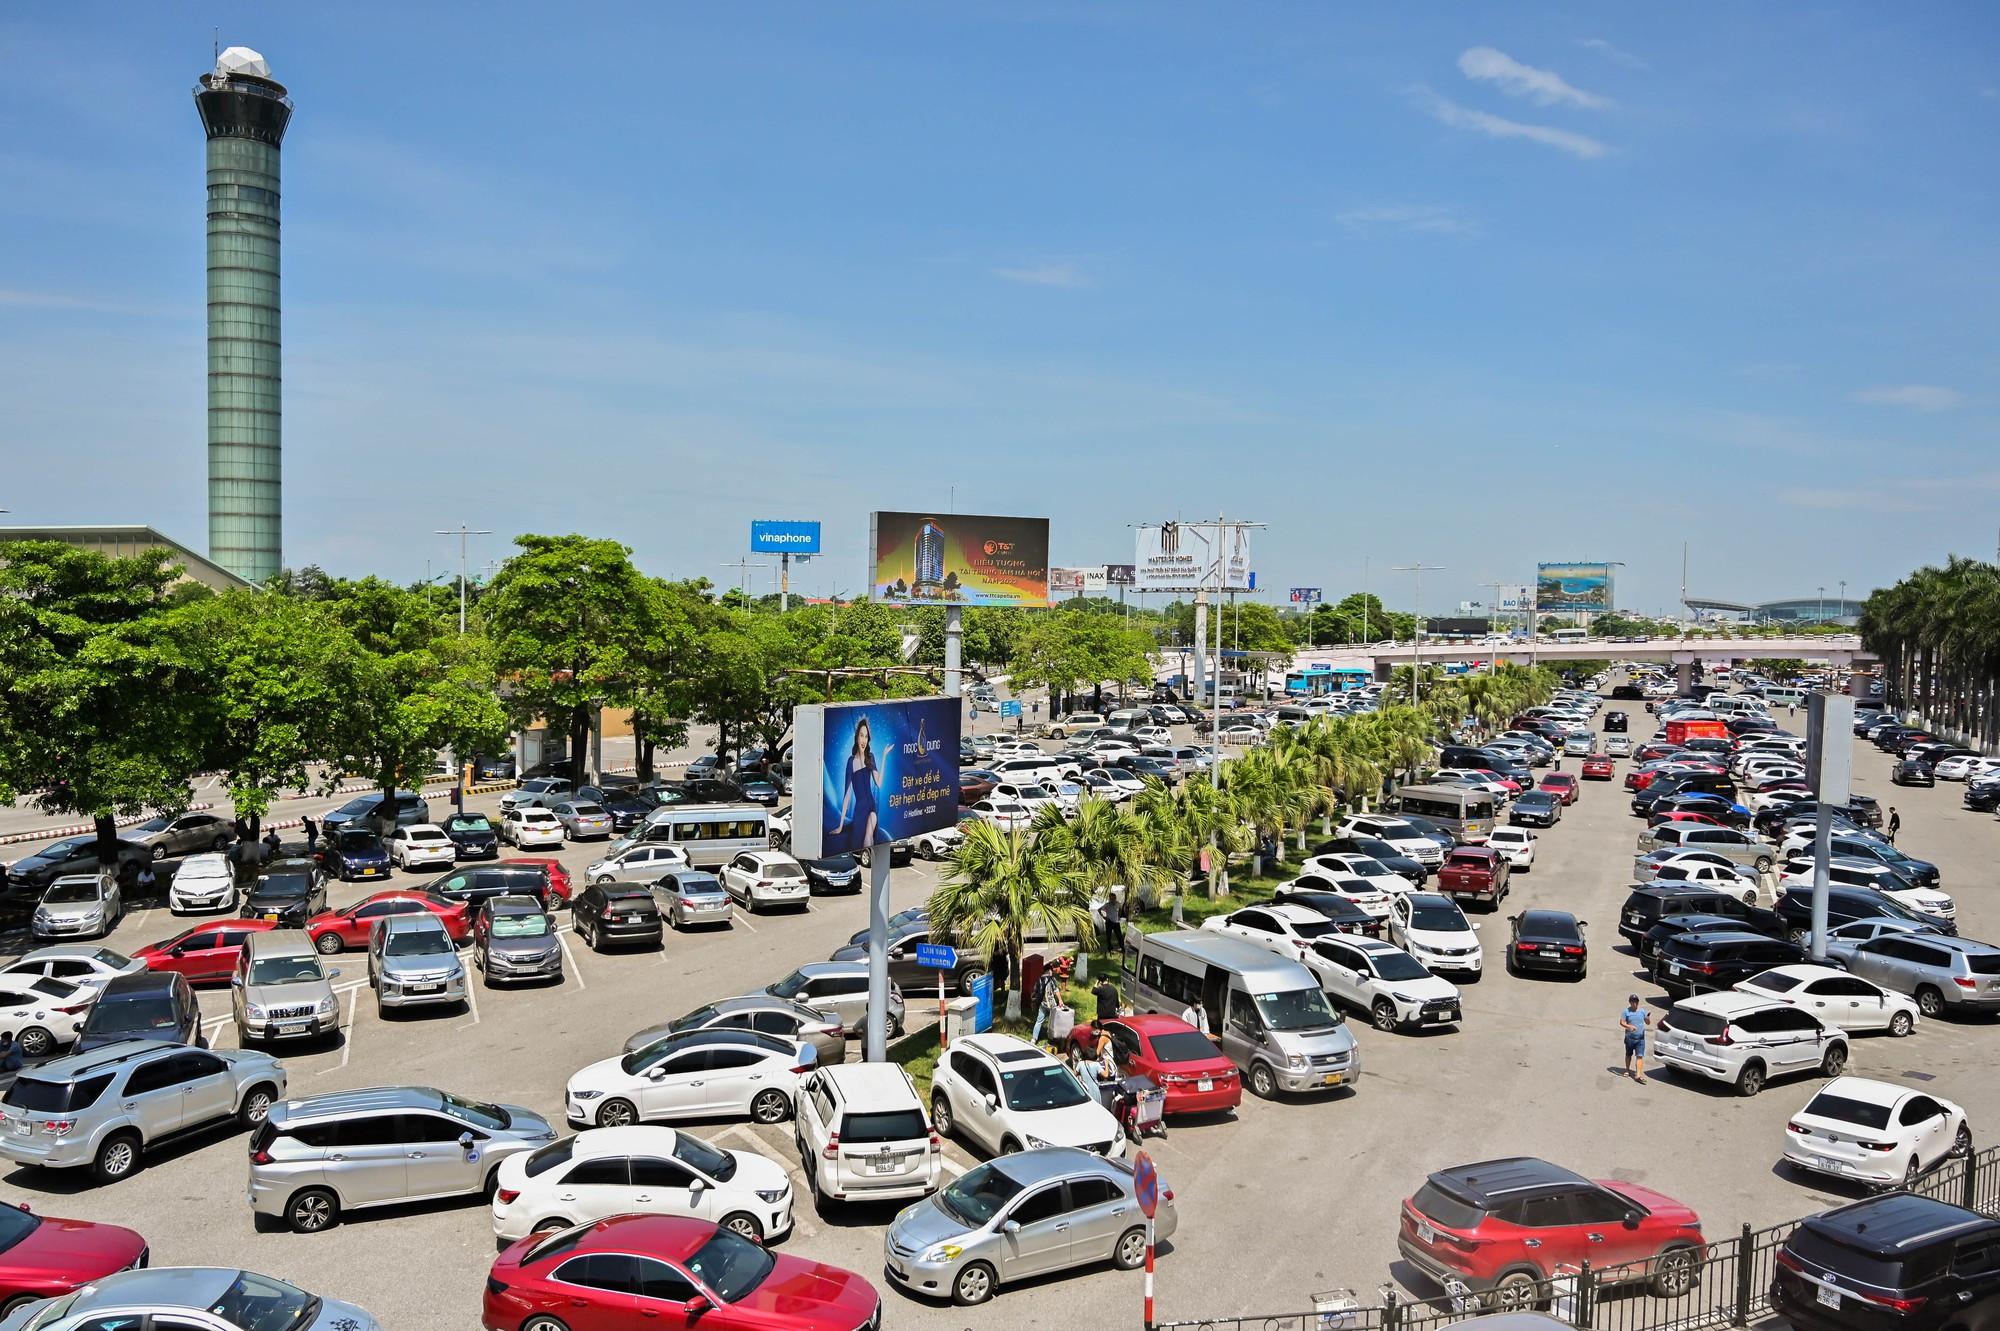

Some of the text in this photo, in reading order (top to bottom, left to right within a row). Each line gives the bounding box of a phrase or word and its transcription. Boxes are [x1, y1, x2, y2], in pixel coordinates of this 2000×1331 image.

[759, 532, 811, 543] vinaphone
[902, 769, 940, 789] Đặt xe để về
[889, 785, 950, 808] Đặt hẹn để đẹp mê
